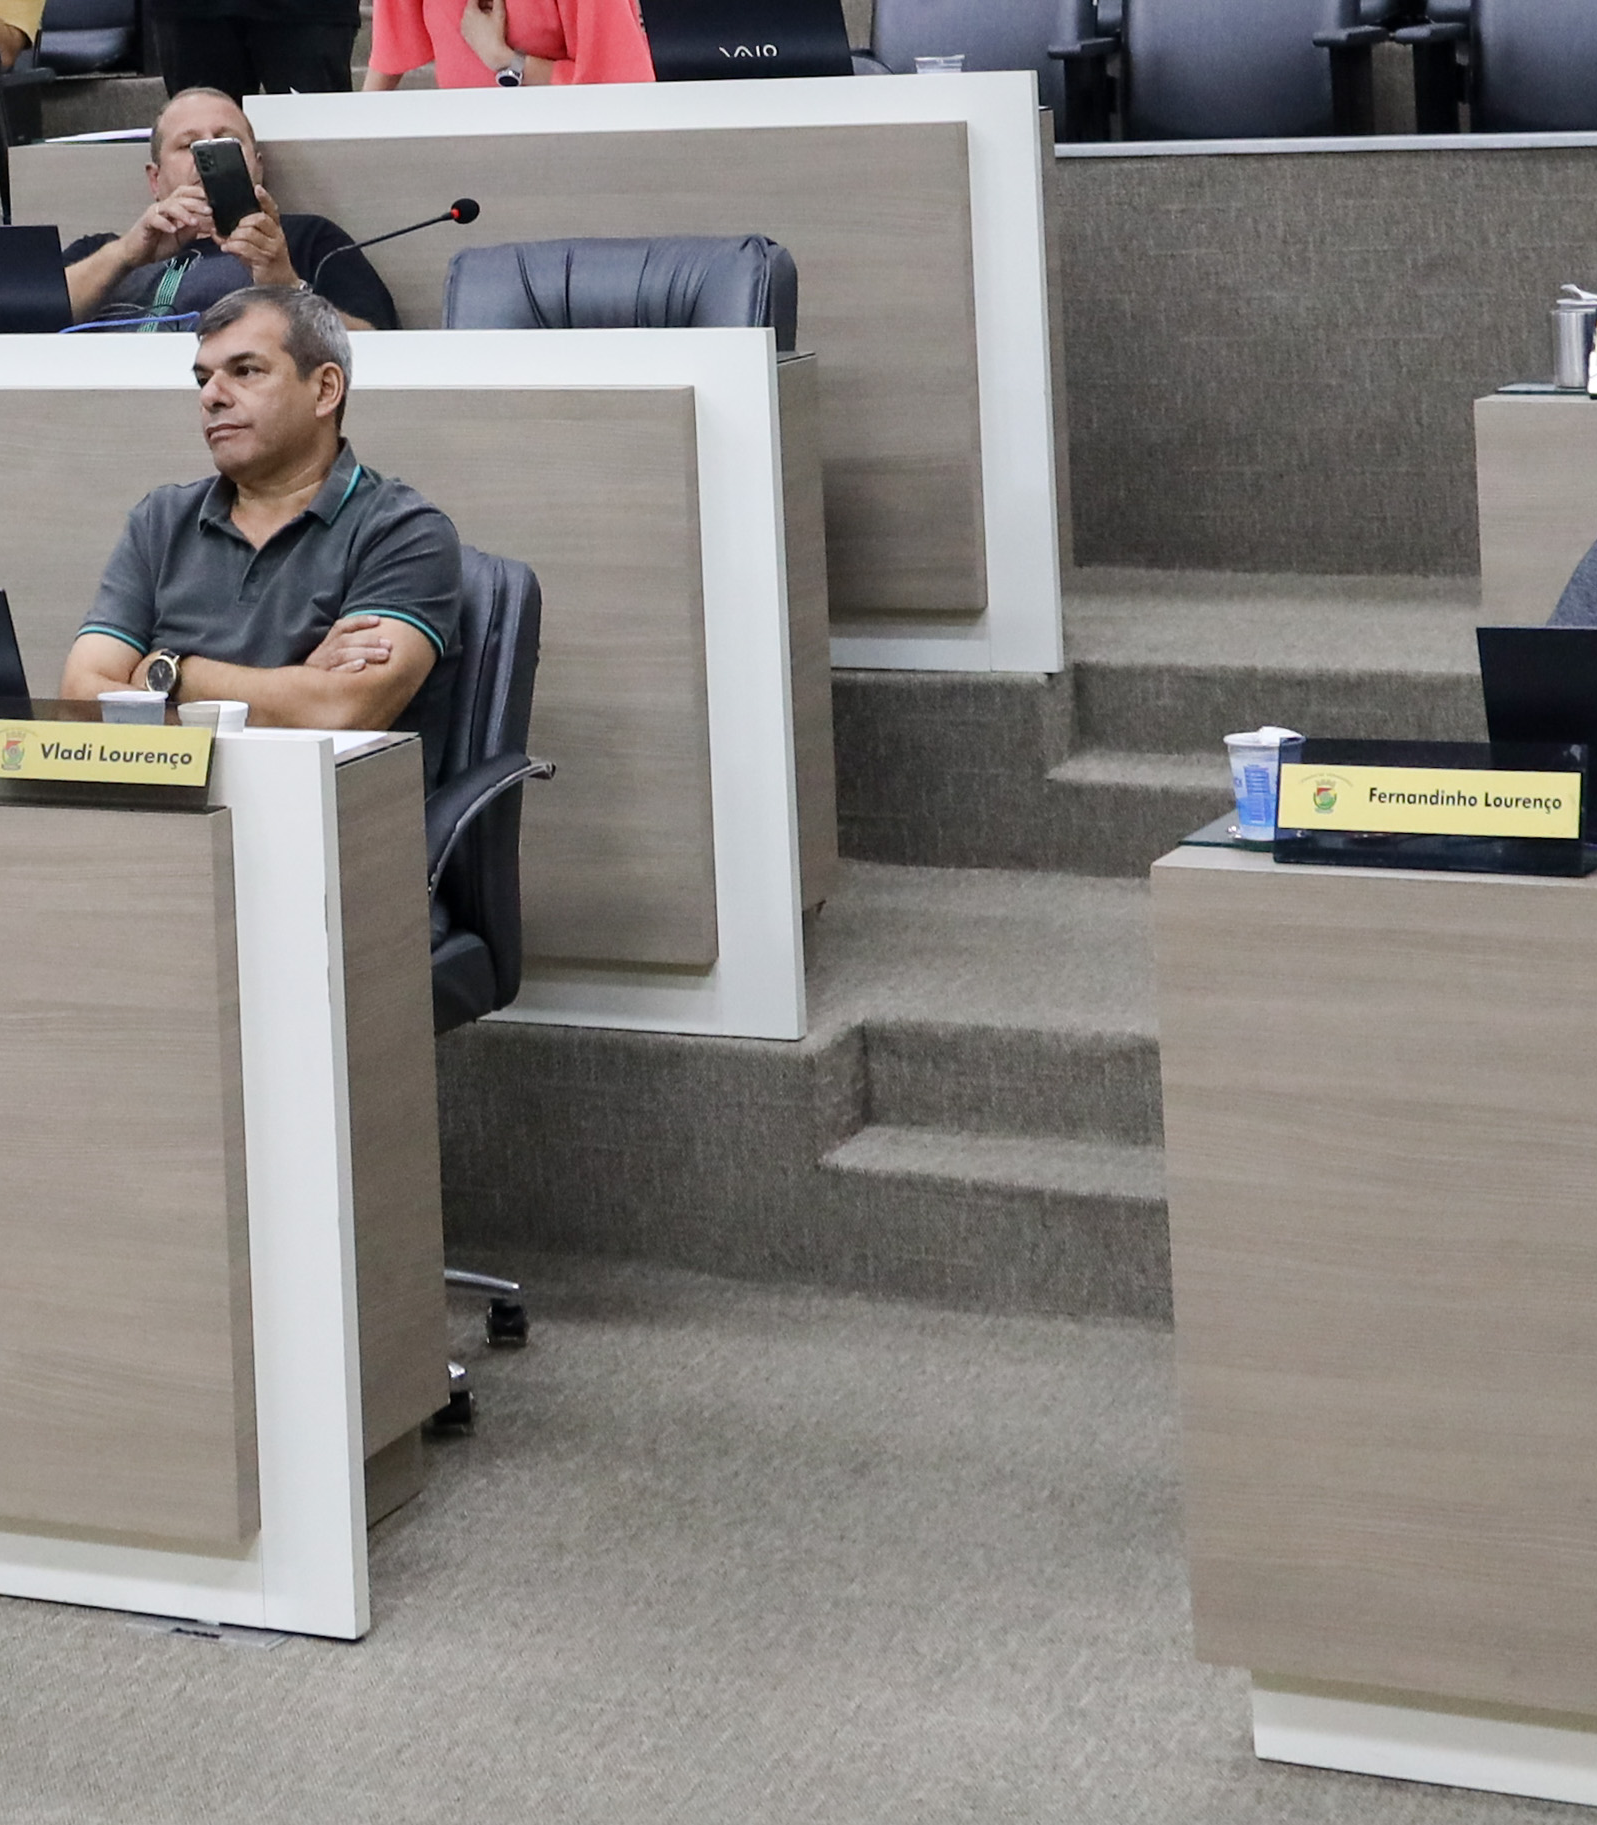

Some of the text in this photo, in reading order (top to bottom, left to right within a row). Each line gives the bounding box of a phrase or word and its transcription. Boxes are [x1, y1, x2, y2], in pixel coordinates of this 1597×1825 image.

[40, 742, 193, 770] Vladi Lourenço
[1368, 787, 1562, 814] Fernandinho Lourenço
